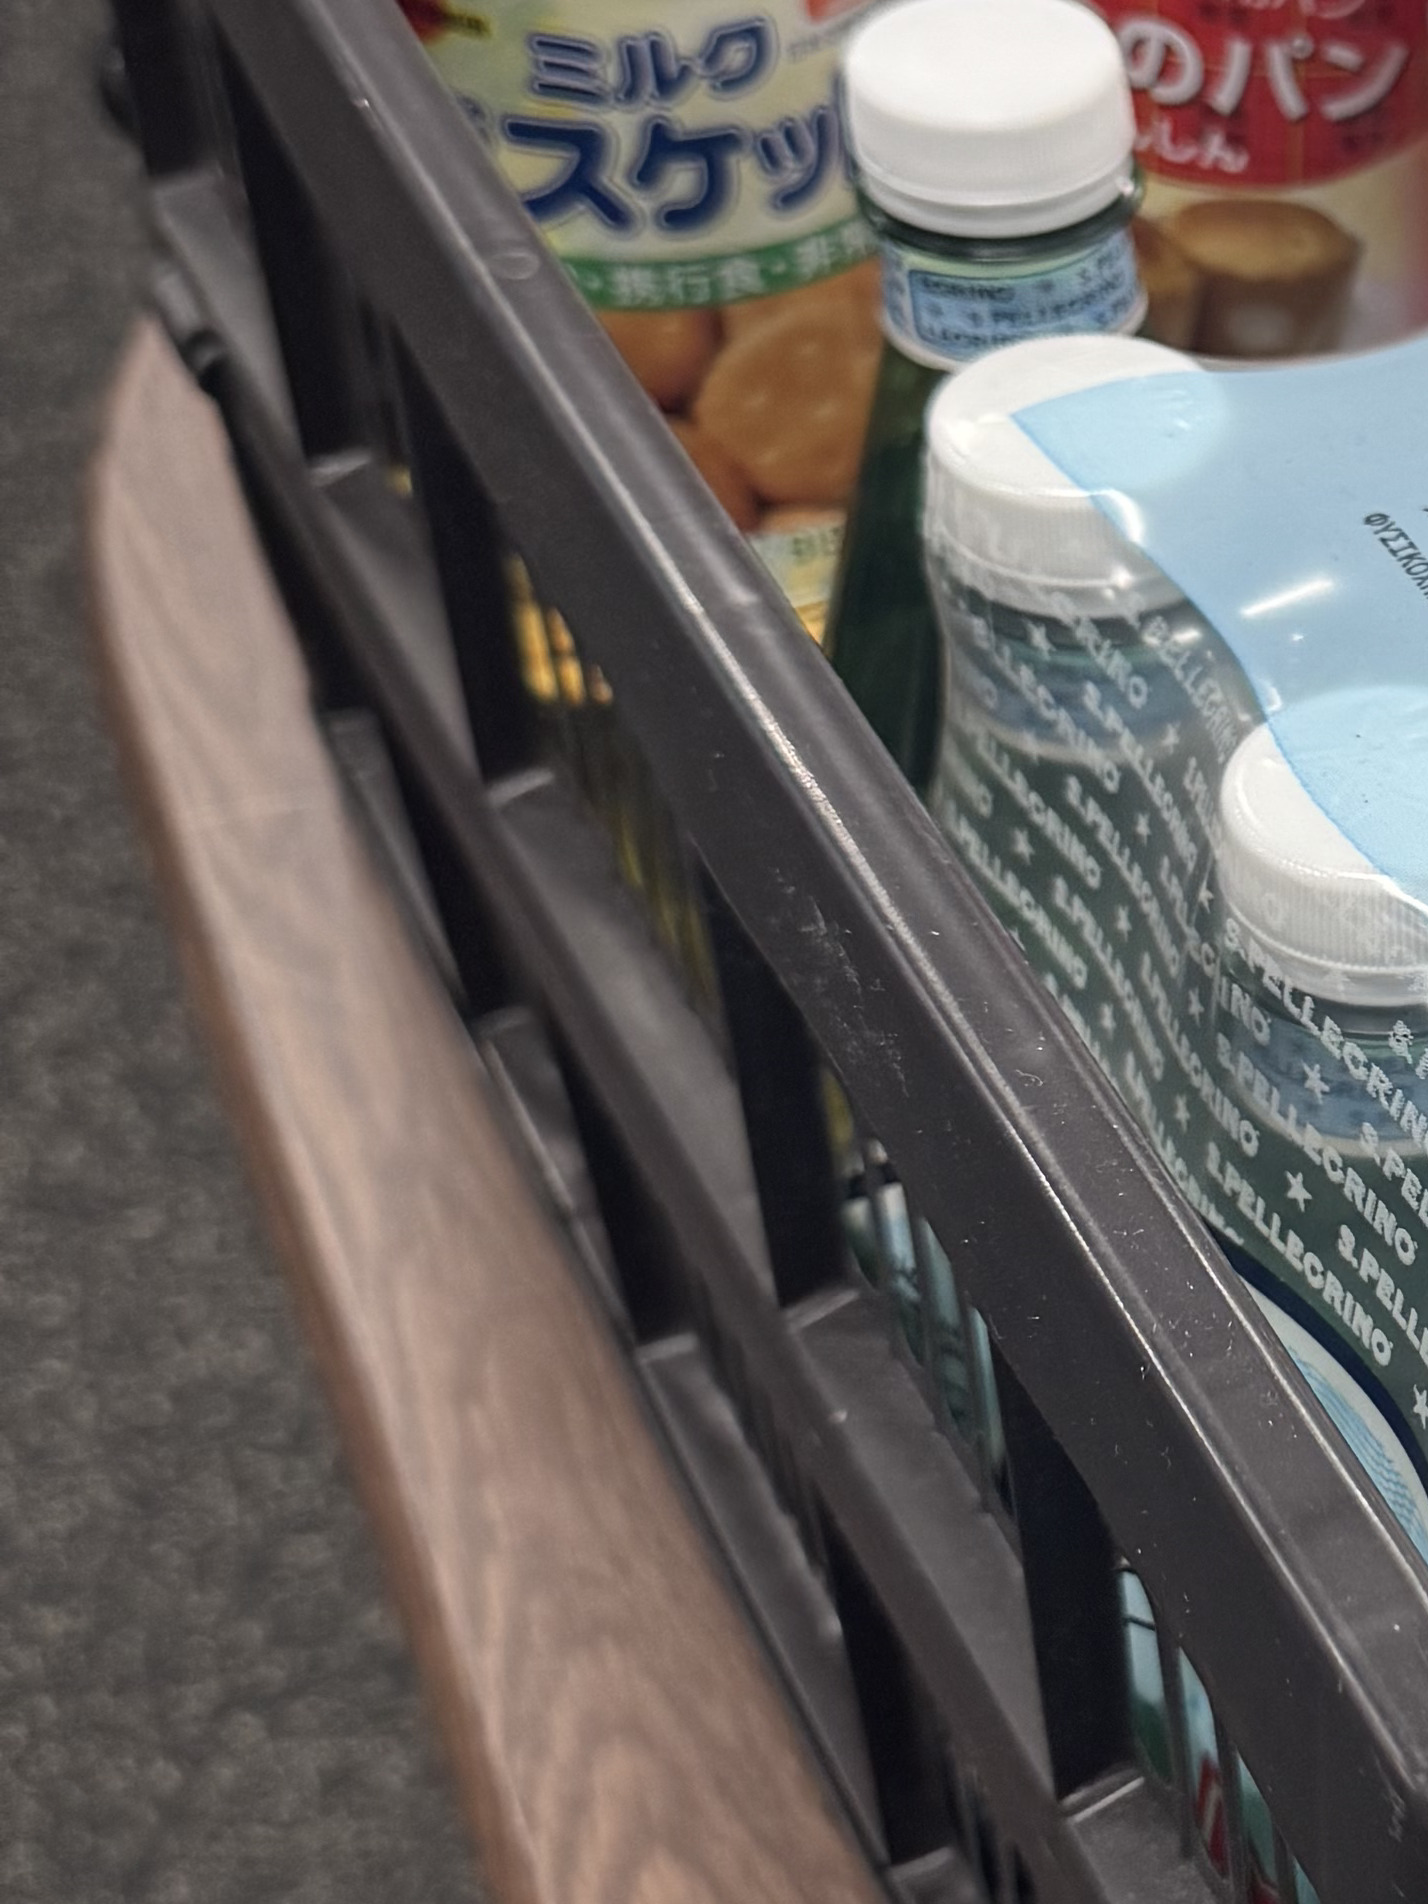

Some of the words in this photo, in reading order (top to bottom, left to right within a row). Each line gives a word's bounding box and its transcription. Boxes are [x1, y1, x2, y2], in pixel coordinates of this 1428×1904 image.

[528, 15, 776, 106] ミルク
[1119, 14, 1410, 123] のパン
[500, 102, 842, 234] スケッ
